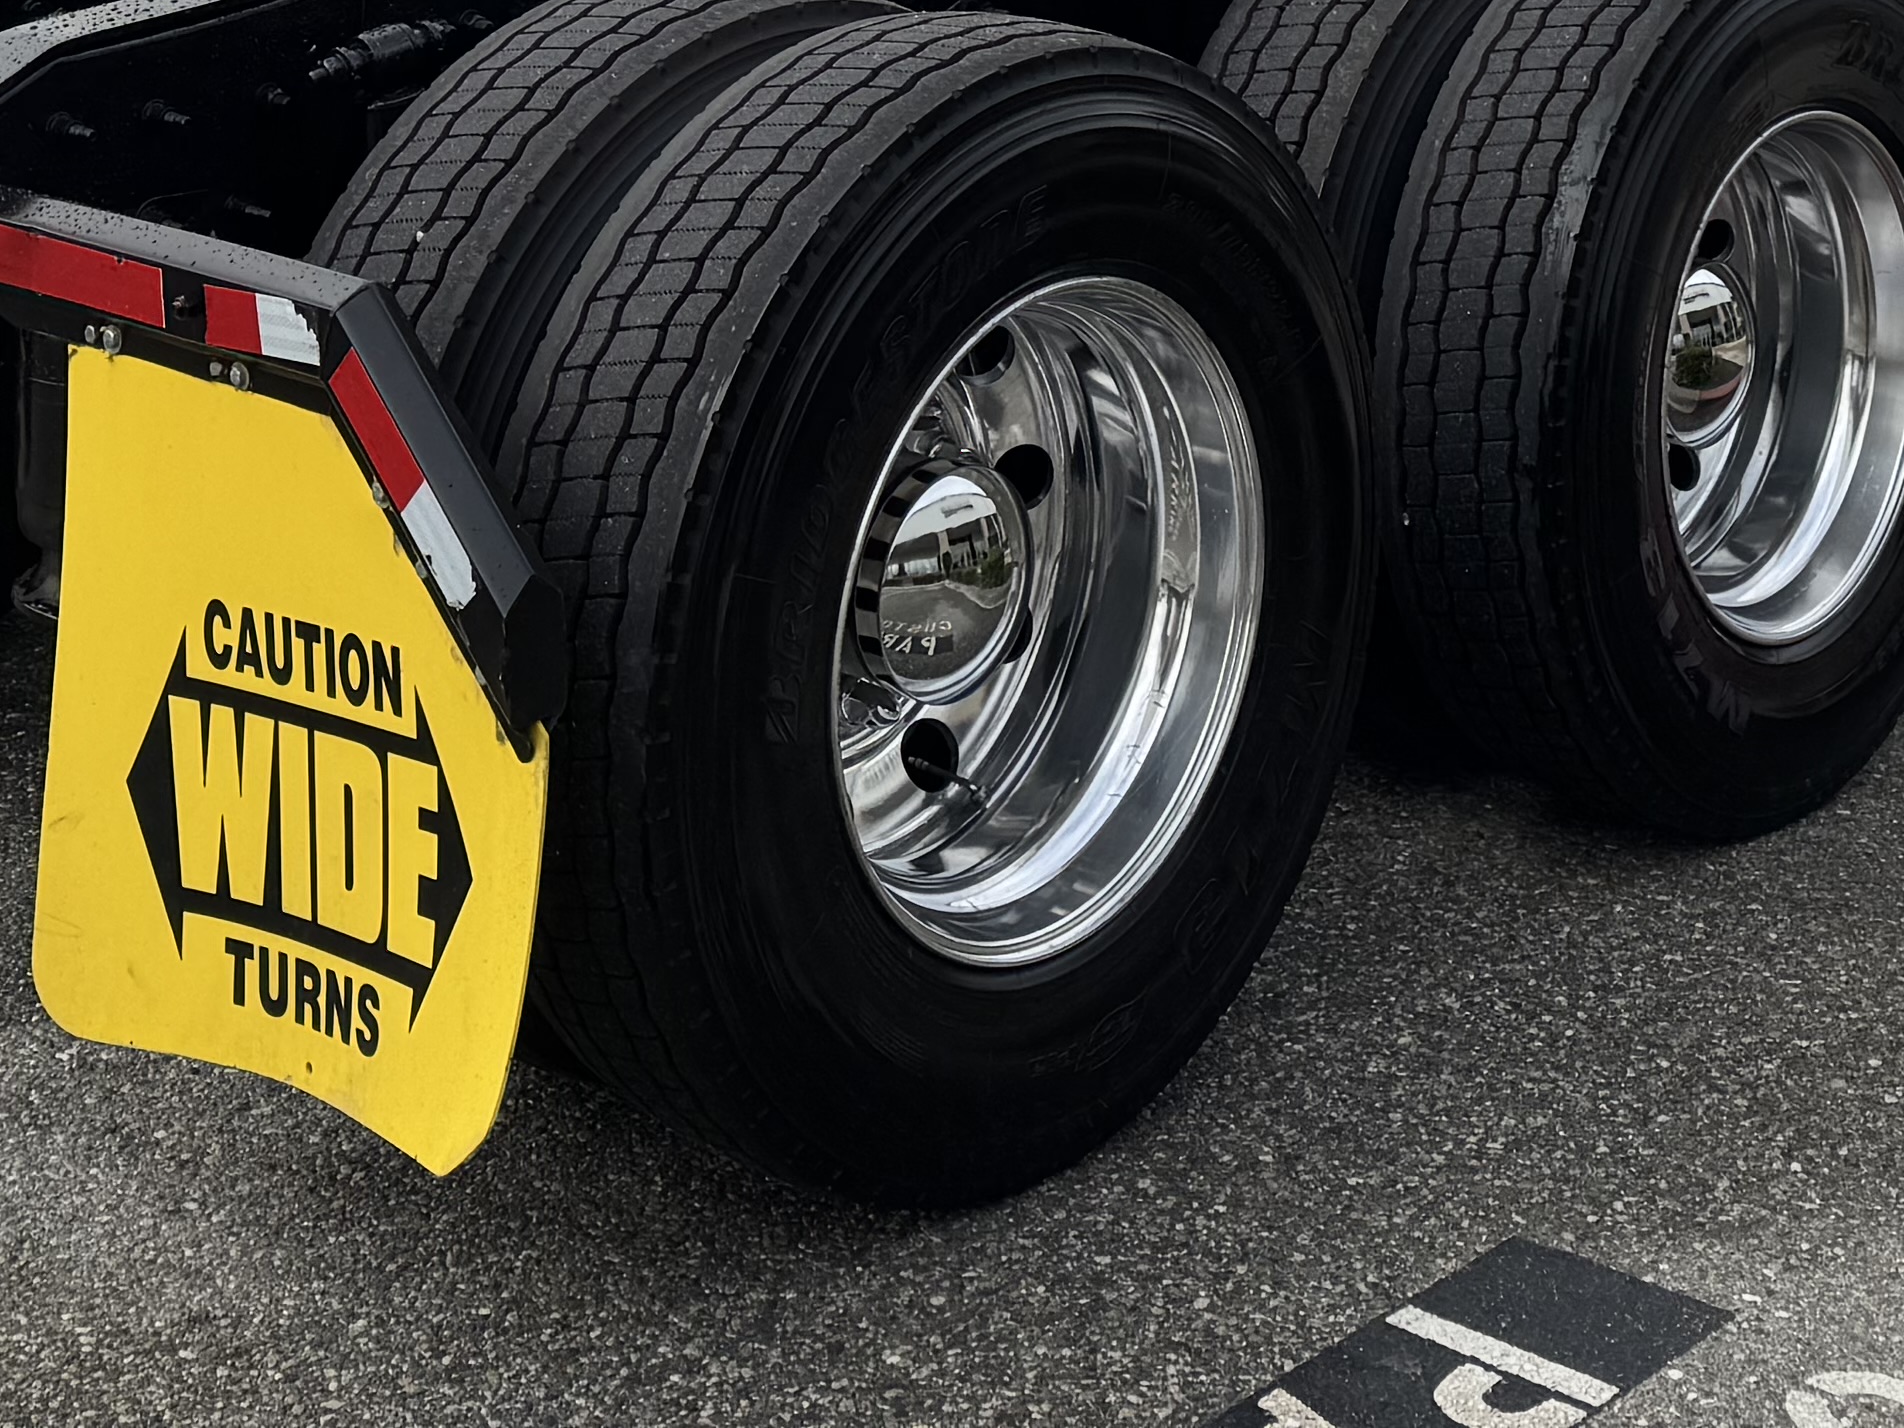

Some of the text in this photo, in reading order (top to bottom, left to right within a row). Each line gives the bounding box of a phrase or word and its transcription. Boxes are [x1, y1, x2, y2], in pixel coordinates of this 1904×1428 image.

[202, 597, 403, 710] CAUTION
[167, 695, 439, 970] WIDE
[223, 937, 381, 1058] TURNS
